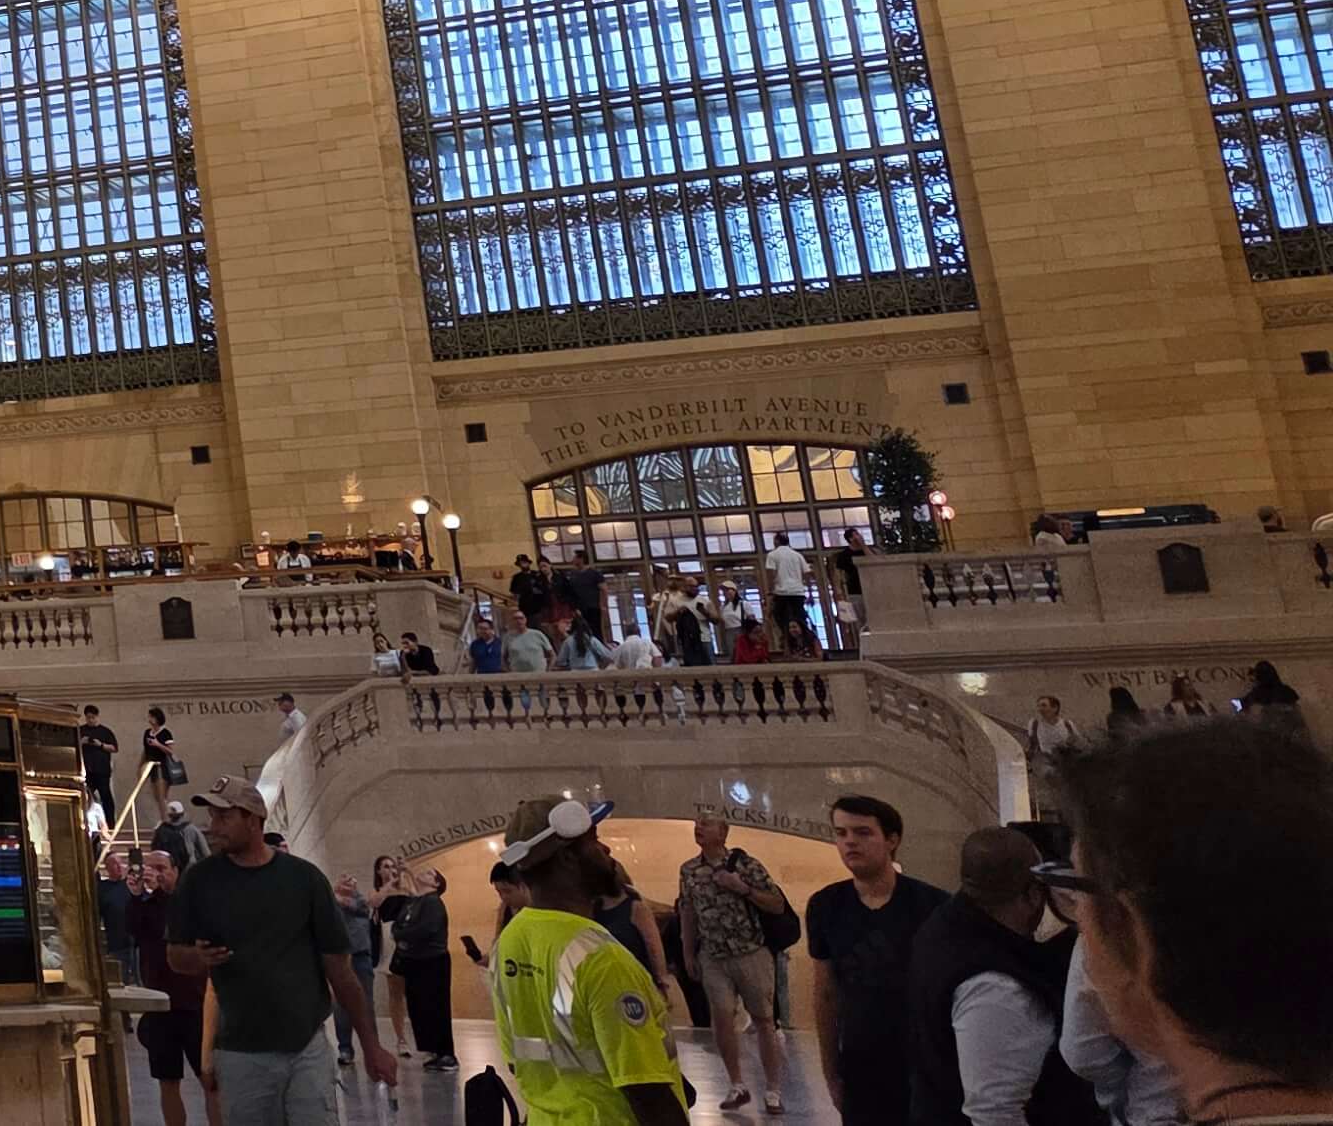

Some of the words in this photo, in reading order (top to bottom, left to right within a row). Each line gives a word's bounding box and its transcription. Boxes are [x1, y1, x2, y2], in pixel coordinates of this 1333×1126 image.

[554, 422, 585, 440] TO
[597, 398, 747, 428] VANDERBILT
[765, 397, 868, 417] AVENUE
[541, 443, 587, 465] THE
[600, 418, 723, 448] CAMPBELL
[400, 831, 445, 857] LONG
[449, 814, 507, 841] ISLAND
